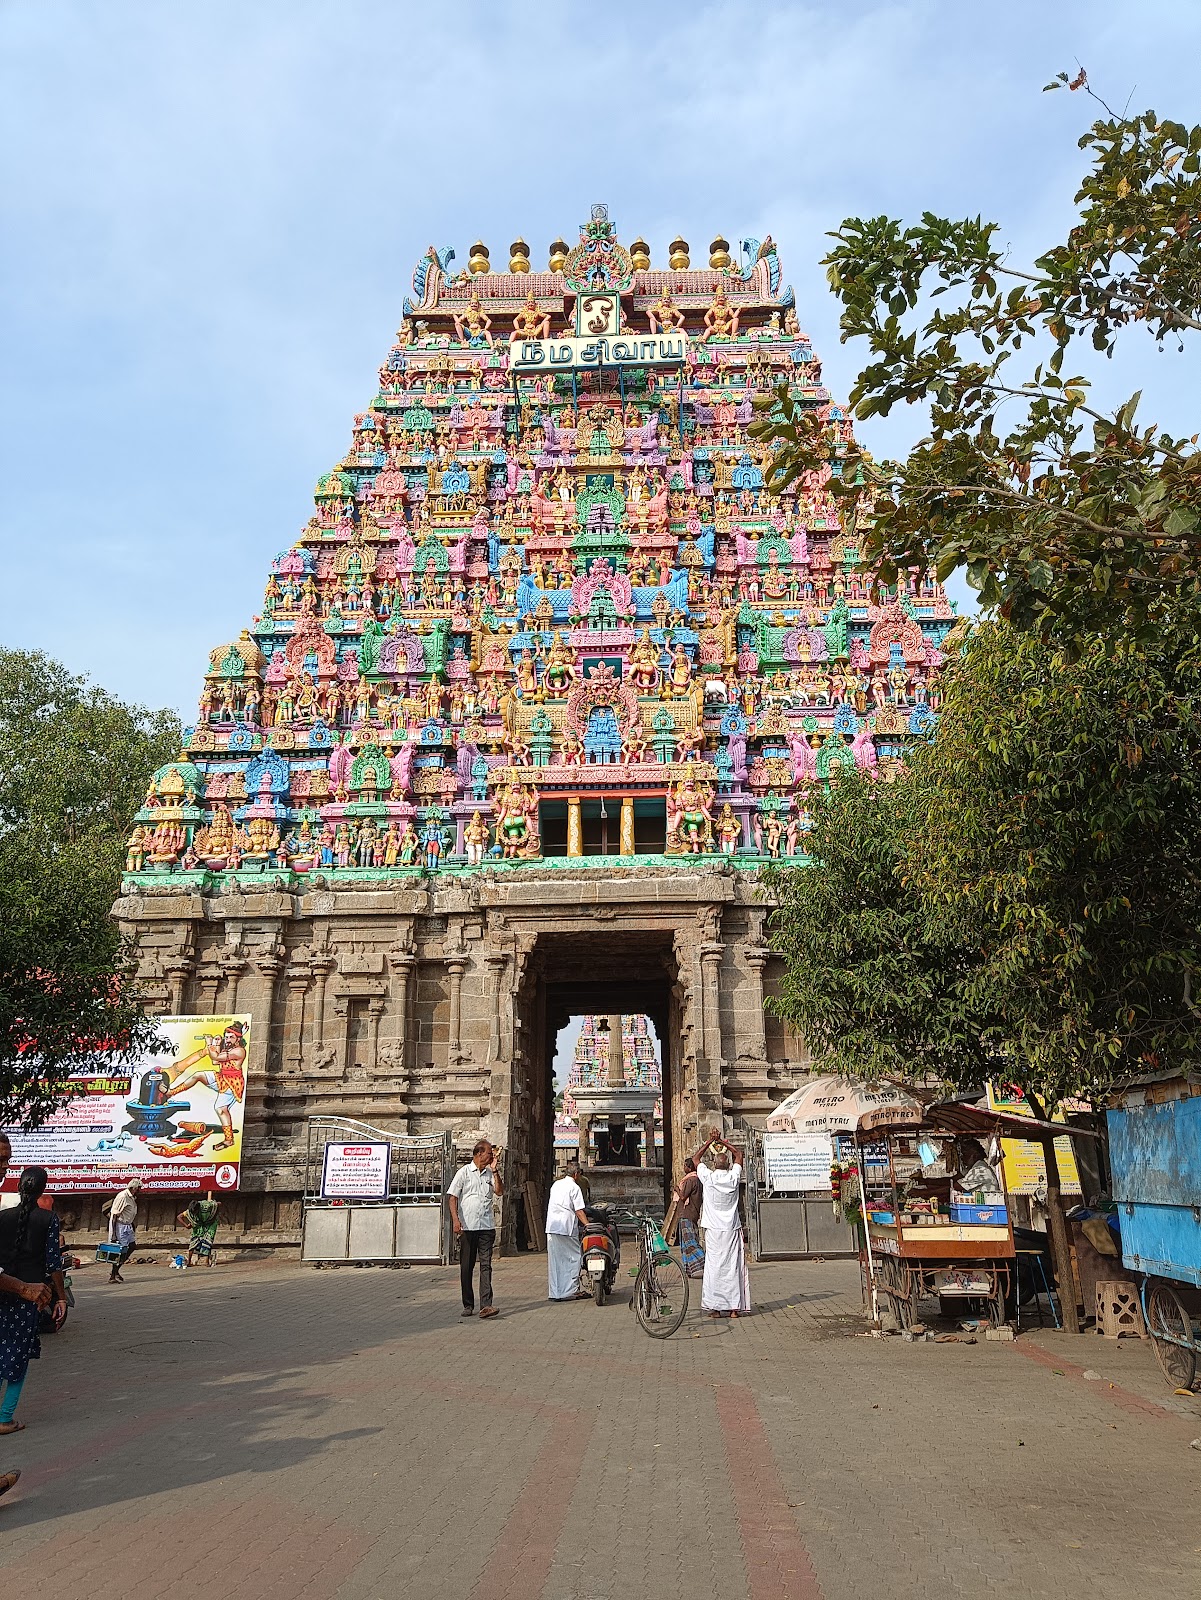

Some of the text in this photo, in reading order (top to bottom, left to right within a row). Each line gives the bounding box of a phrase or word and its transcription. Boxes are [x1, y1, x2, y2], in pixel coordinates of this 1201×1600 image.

[813, 1096, 845, 1104] METRO
[865, 1092, 895, 1101] METRO
[870, 1112, 891, 1122] METRO
[805, 1117, 827, 1127] METRO
[830, 1117, 849, 1125] TYRES
